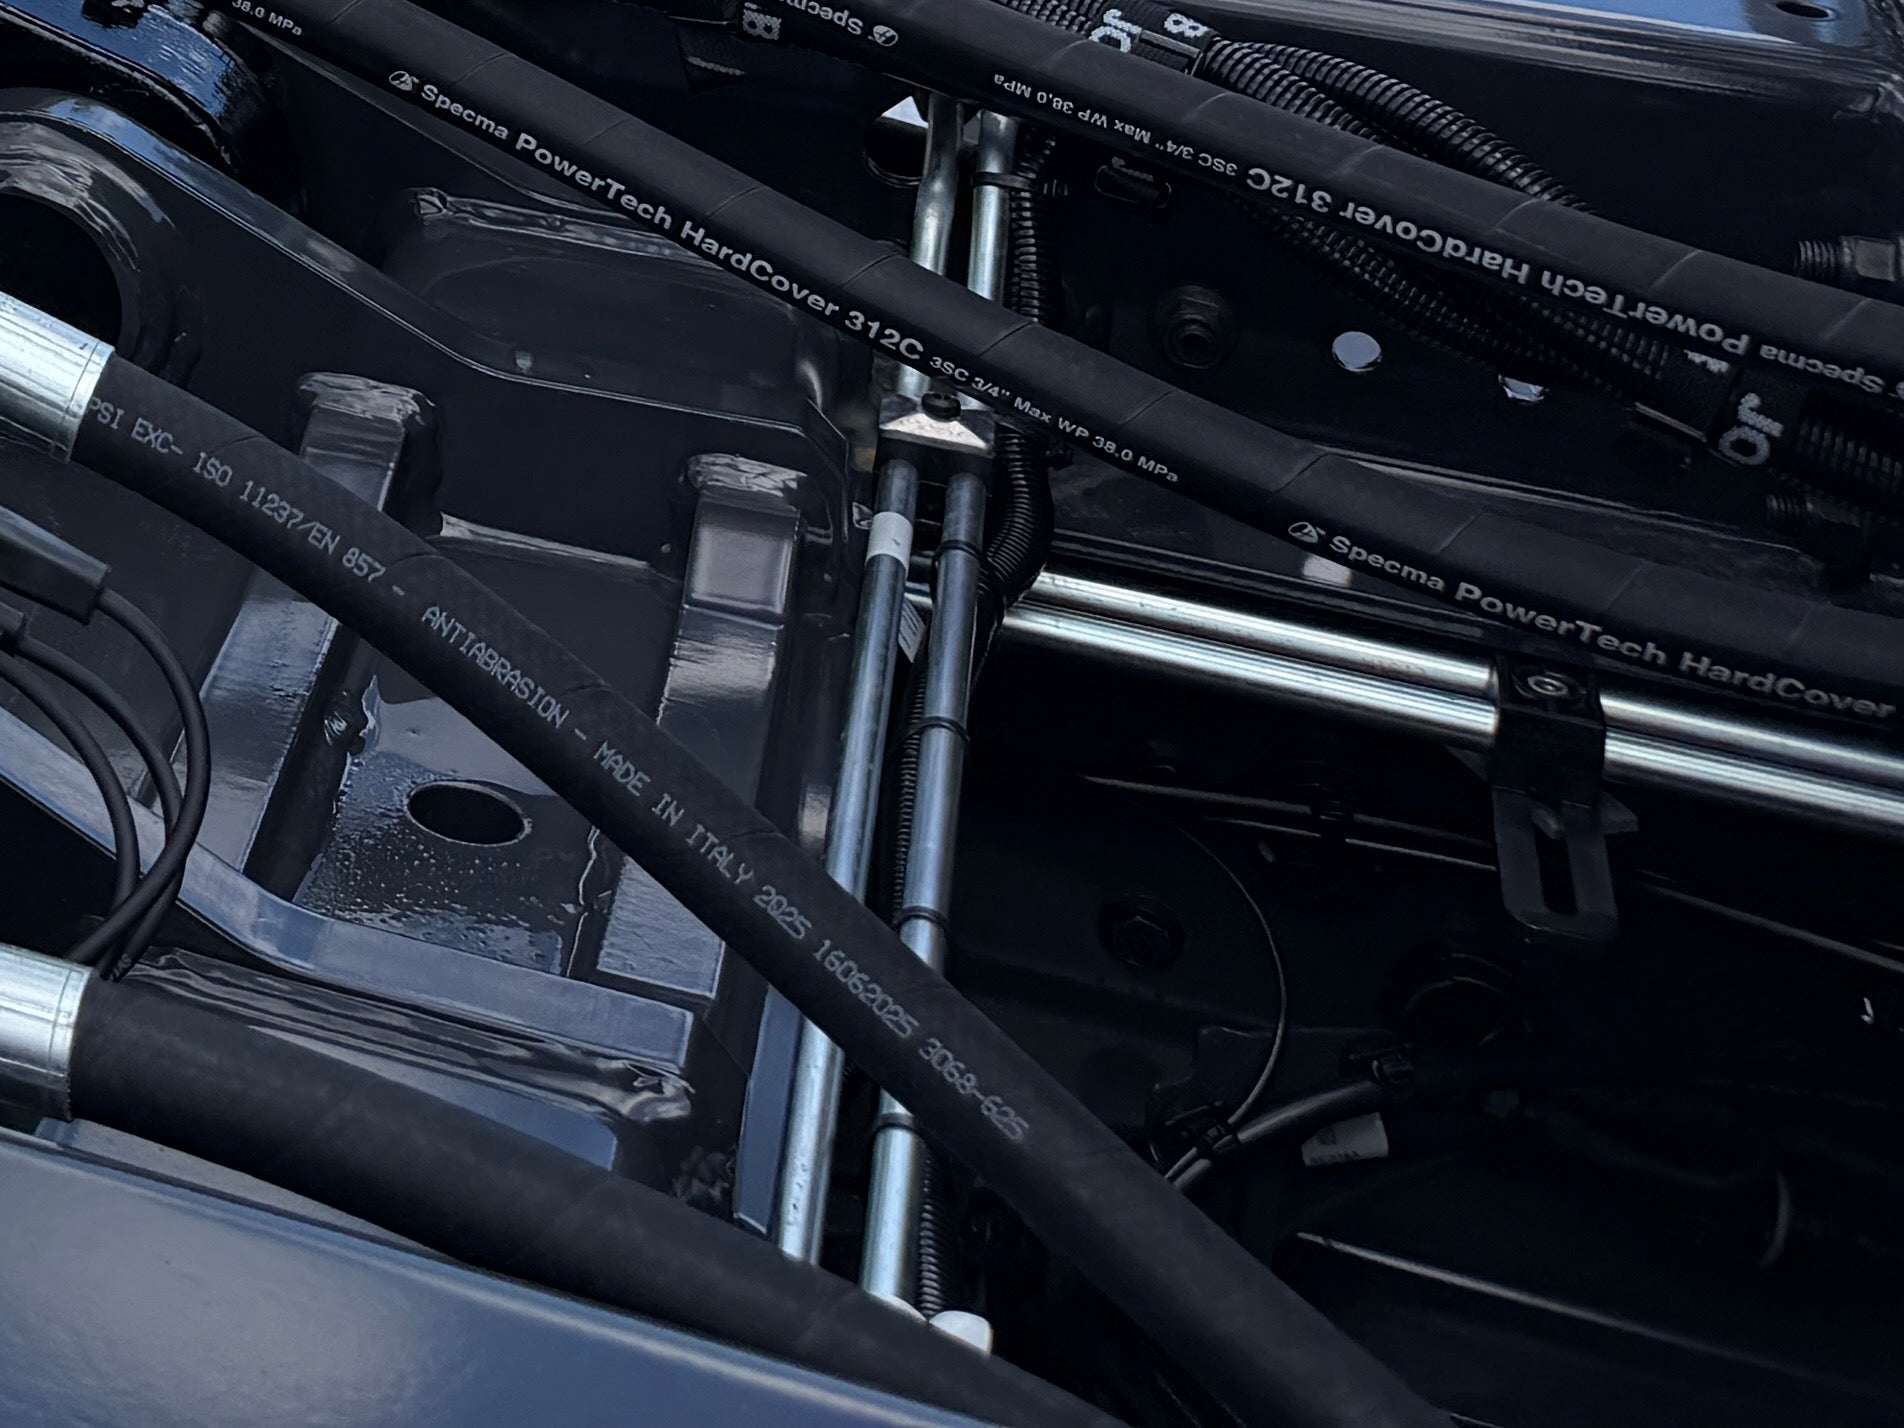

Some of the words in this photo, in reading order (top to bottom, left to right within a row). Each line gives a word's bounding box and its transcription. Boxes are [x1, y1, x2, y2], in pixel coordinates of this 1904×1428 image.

[268, 11, 303, 37] MPa
[993, 72, 1032, 99] MPa
[1036, 90, 1075, 115] 38.0
[1078, 110, 1108, 130] WP
[1114, 118, 1151, 145] Max
[1197, 151, 1238, 176] 3SC
[1246, 167, 1333, 214] 312C
[1339, 201, 1531, 286] HardCover
[420, 83, 509, 141] Specma
[515, 132, 672, 231] PowerTech
[679, 220, 840, 317] HardCover
[844, 310, 925, 360] 312C
[929, 356, 970, 382] 3SC
[1012, 396, 1052, 424] Max
[1057, 416, 1090, 439] WP
[1091, 434, 1135, 462] 38.0
[1137, 455, 1180, 484] MPa
[1540, 270, 1750, 356] PowerTech
[1759, 343, 1886, 394] Specma
[1328, 534, 1446, 593] Specma
[1453, 581, 1669, 666] PowerTech
[1678, 650, 1898, 719] HardCover
[191, 451, 234, 488] ISO
[238, 480, 341, 557] 11237/EN
[341, 547, 387, 584] 857
[421, 605, 571, 729] ANTIABRASION
[593, 741, 652, 797] MADE
[650, 792, 686, 827] IN
[685, 823, 754, 886] ITALY
[812, 939, 921, 1039] 16062025
[918, 1037, 1031, 1143] 3068-625
